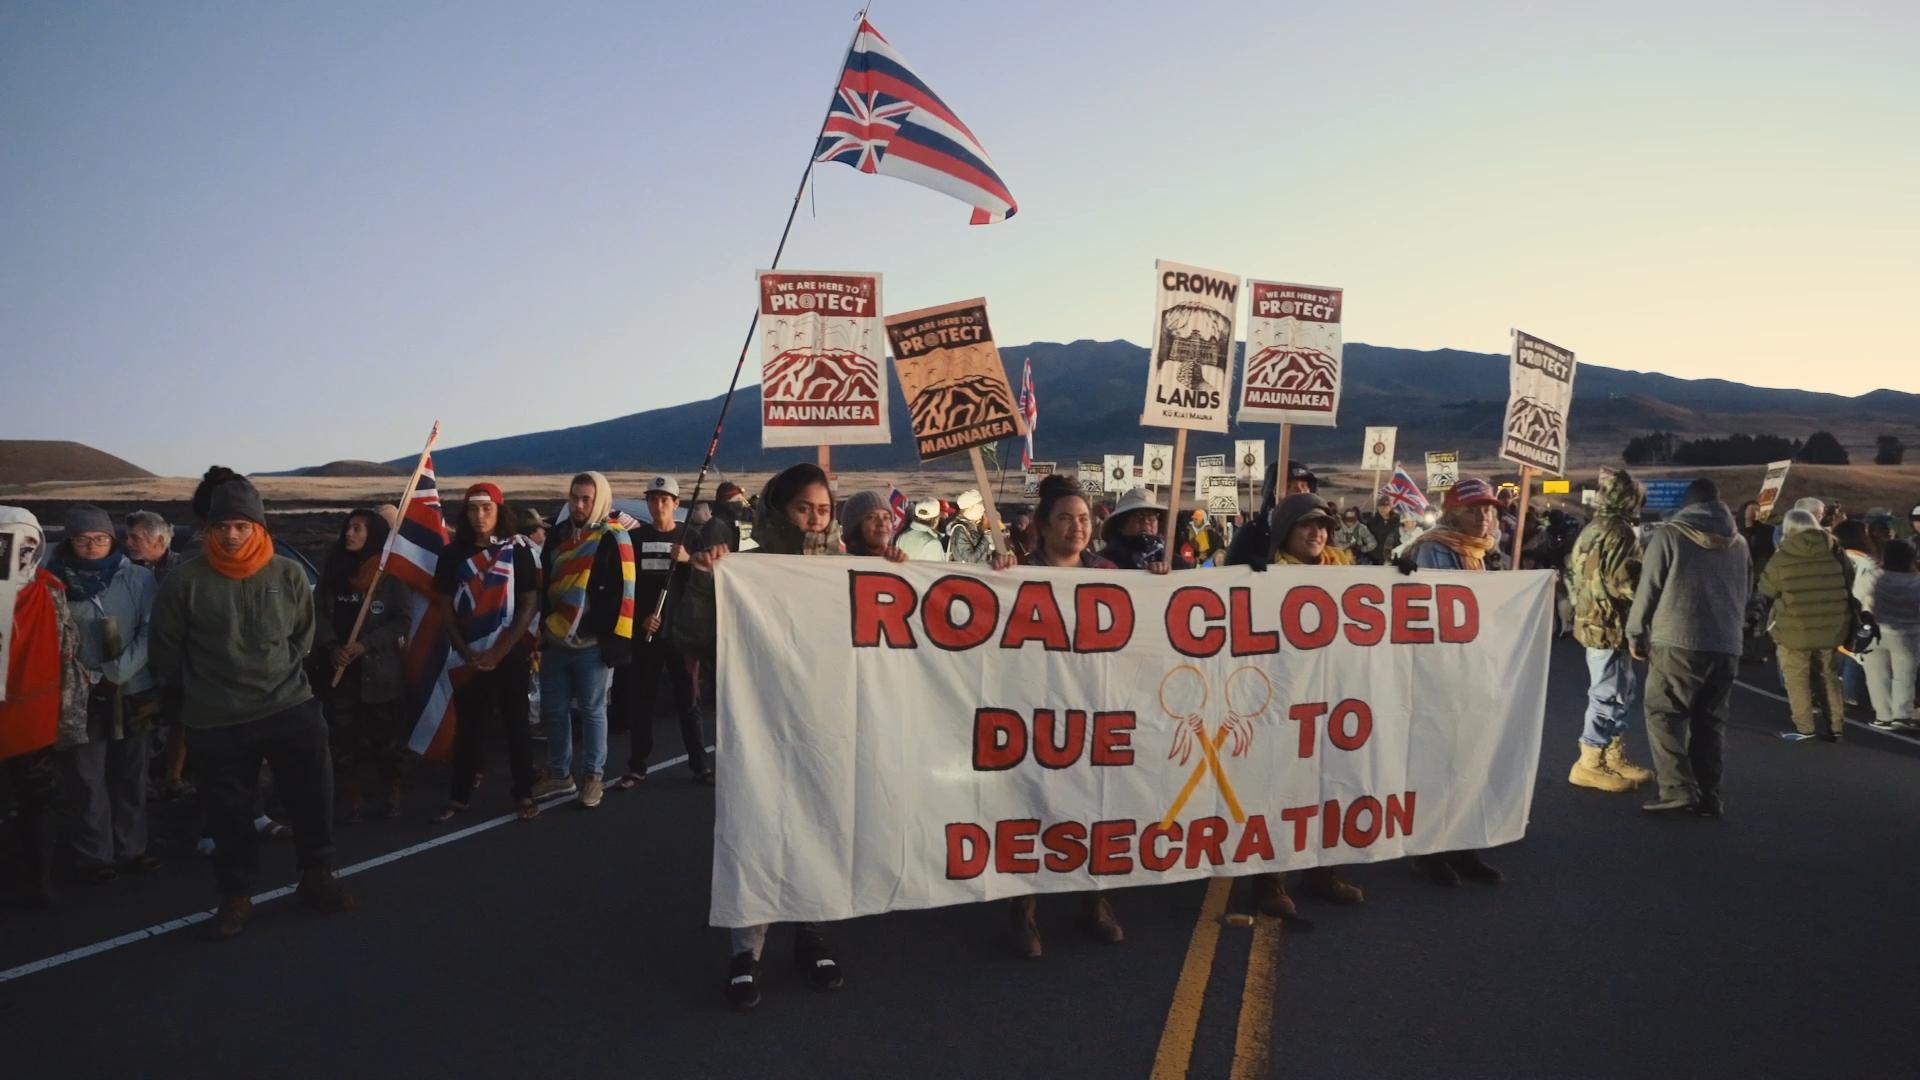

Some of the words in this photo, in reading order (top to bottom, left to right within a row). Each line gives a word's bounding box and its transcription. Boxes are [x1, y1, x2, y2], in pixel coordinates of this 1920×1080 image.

[777, 282, 794, 292] WE
[796, 281, 816, 290] ARE
[818, 282, 844, 292] HERE
[845, 285, 859, 294] TO
[1162, 271, 1238, 303] CROWN
[1265, 291, 1279, 299] WE
[1296, 292, 1317, 302] HERE
[1318, 296, 1329, 304] TO
[770, 293, 867, 314] PROTECT
[1260, 300, 1334, 320] PROTECT
[902, 326, 917, 337] WE
[918, 321, 936, 332] ARE
[937, 317, 960, 327] HERE
[960, 316, 974, 324] TO
[899, 325, 982, 356] PROTECT
[1520, 348, 1568, 379] PROTECT
[1156, 384, 1220, 409] LANDS
[1248, 390, 1330, 407] MAUNAKEA
[768, 405, 875, 420] MAUNAKEA
[921, 422, 1014, 454] MAUNAKEA
[1507, 439, 1559, 467] MAUNAKEA
[848, 570, 1135, 654] ROAD
[1164, 582, 1480, 658] CLOSED
[972, 707, 1136, 771] DUE
[1289, 698, 1373, 759] TO
[945, 791, 1416, 880] DESECRATION
